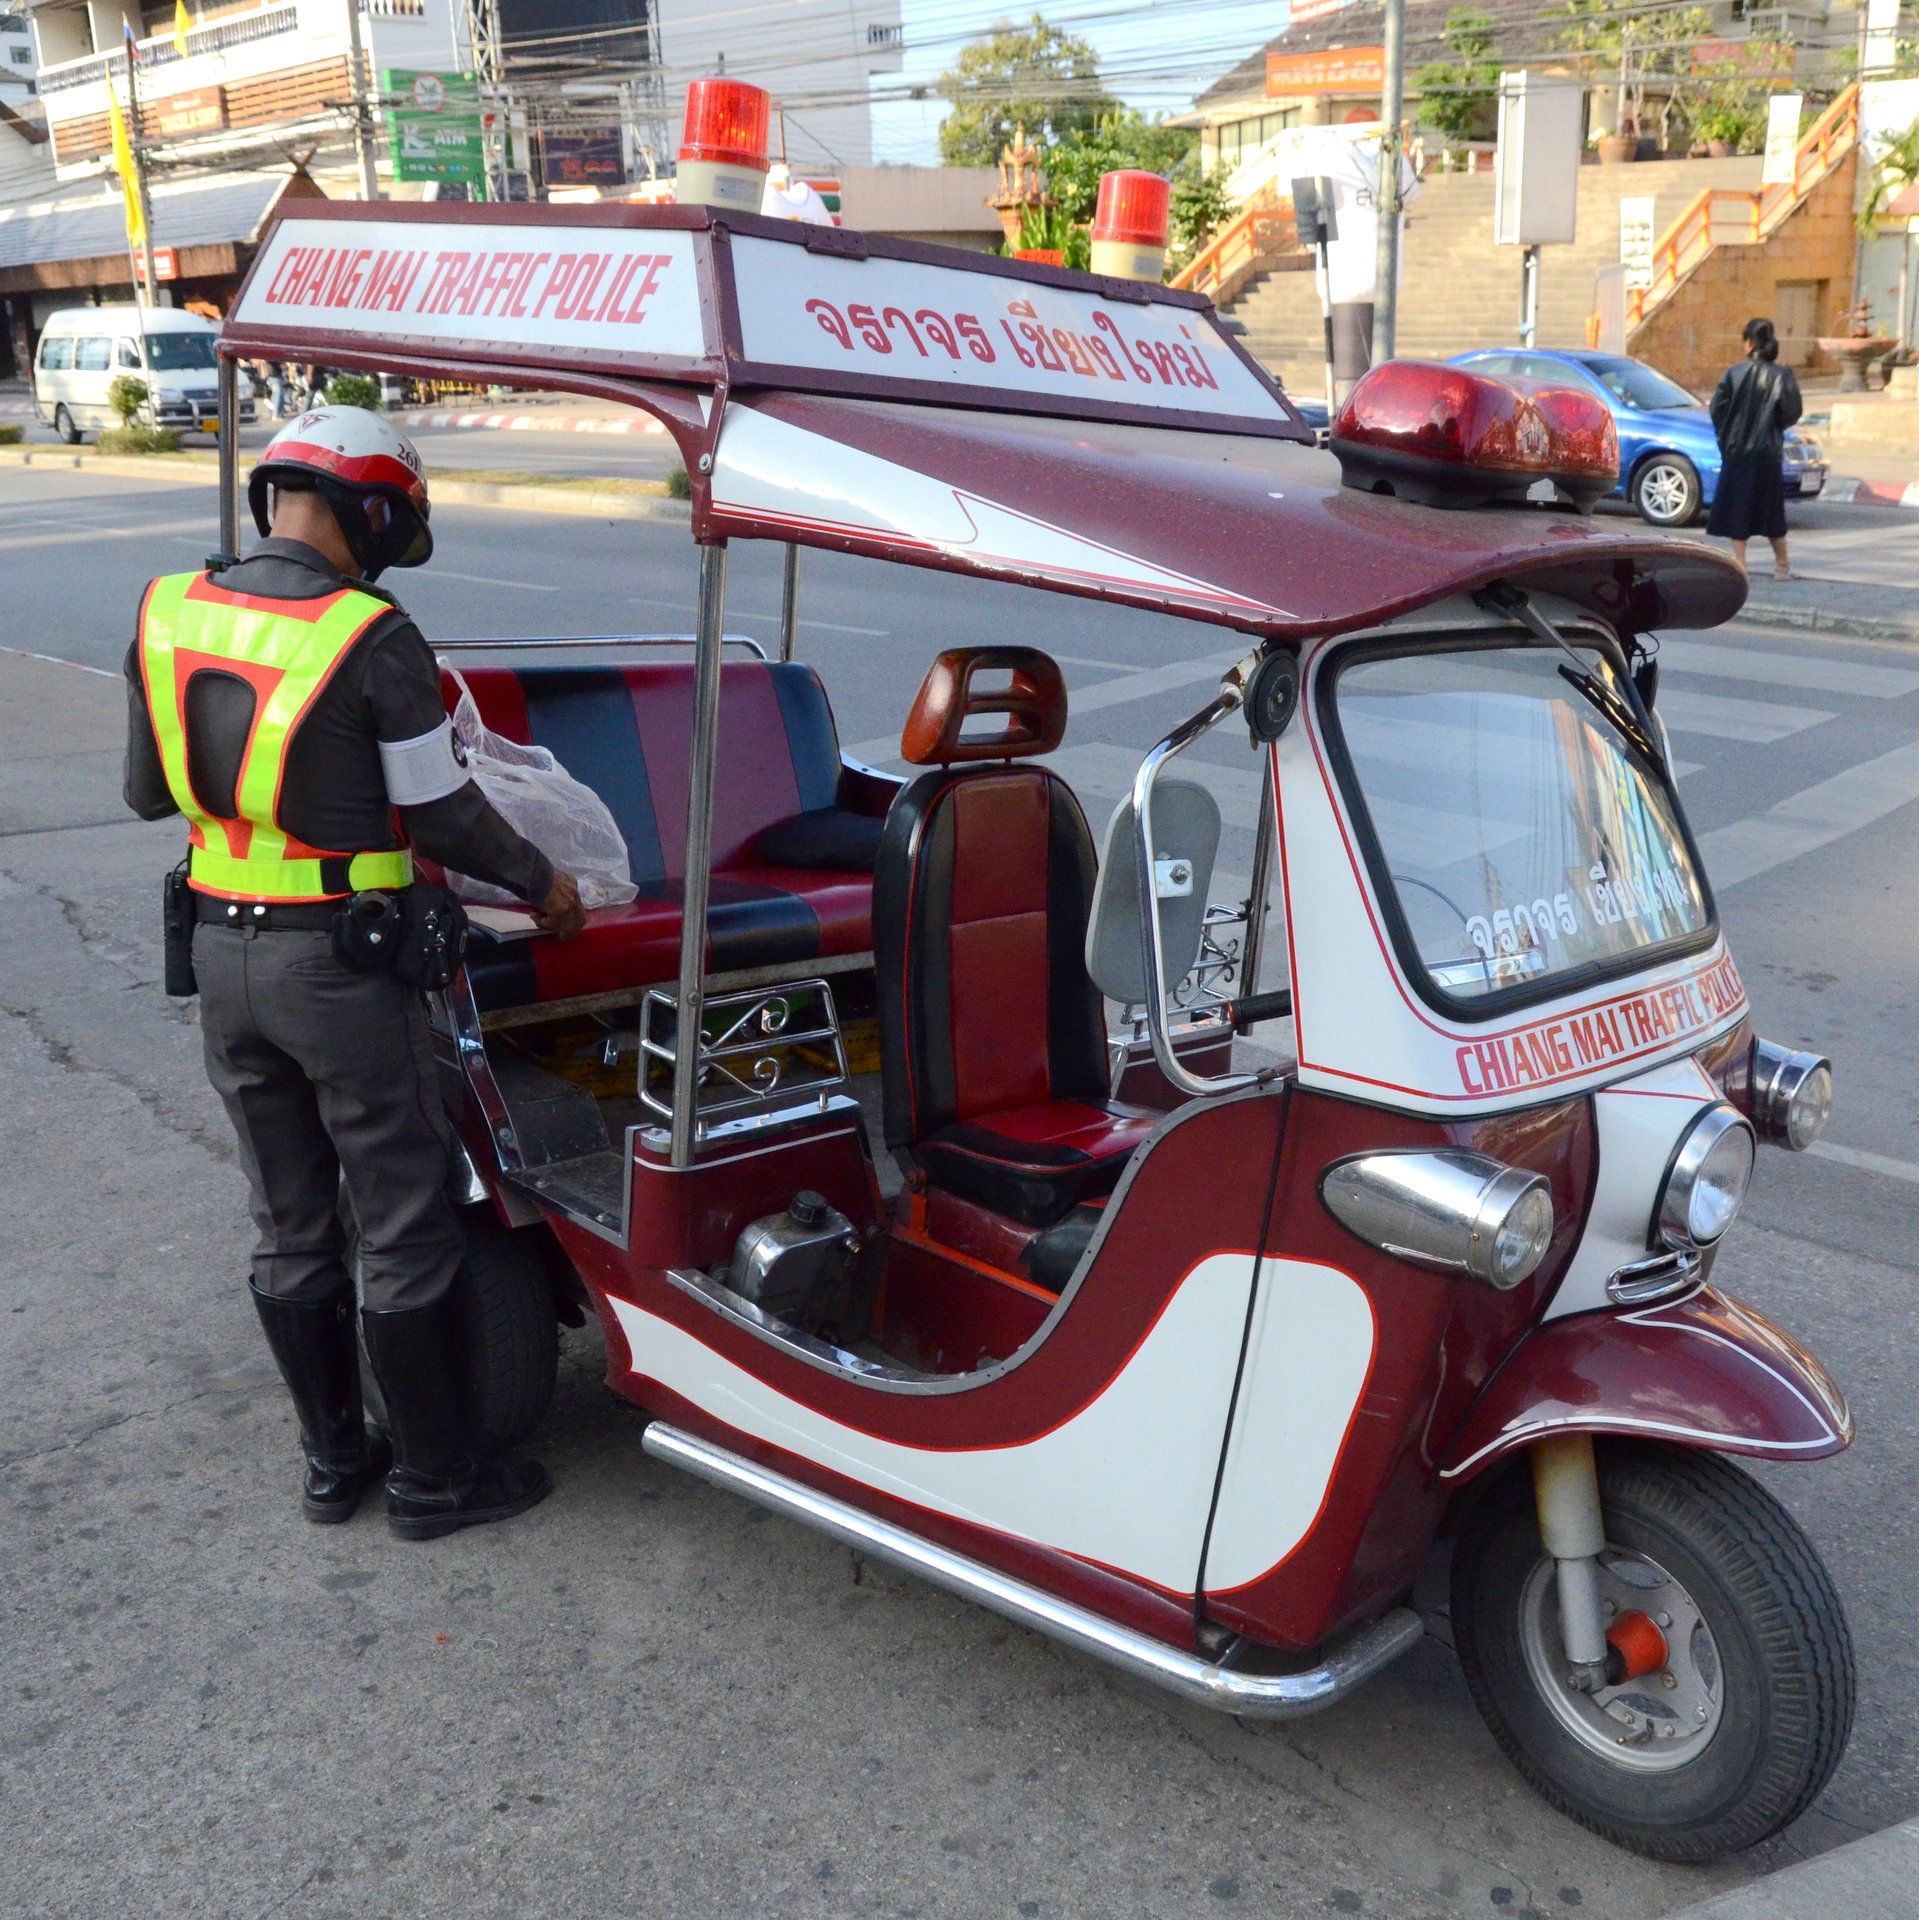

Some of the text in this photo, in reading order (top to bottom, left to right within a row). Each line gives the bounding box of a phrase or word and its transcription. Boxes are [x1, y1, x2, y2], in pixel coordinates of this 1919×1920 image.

[434, 129, 467, 146] ATM
[265, 247, 673, 324] CHIANG MAI TRAFFIC POLICE
[805, 297, 1220, 391] จราจร เชียงใหม่
[396, 443, 418, 471] 261
[1466, 893, 1578, 960] จราจร
[1455, 955, 1743, 1094] CHIANG MAI TRAFFIC POLICE
